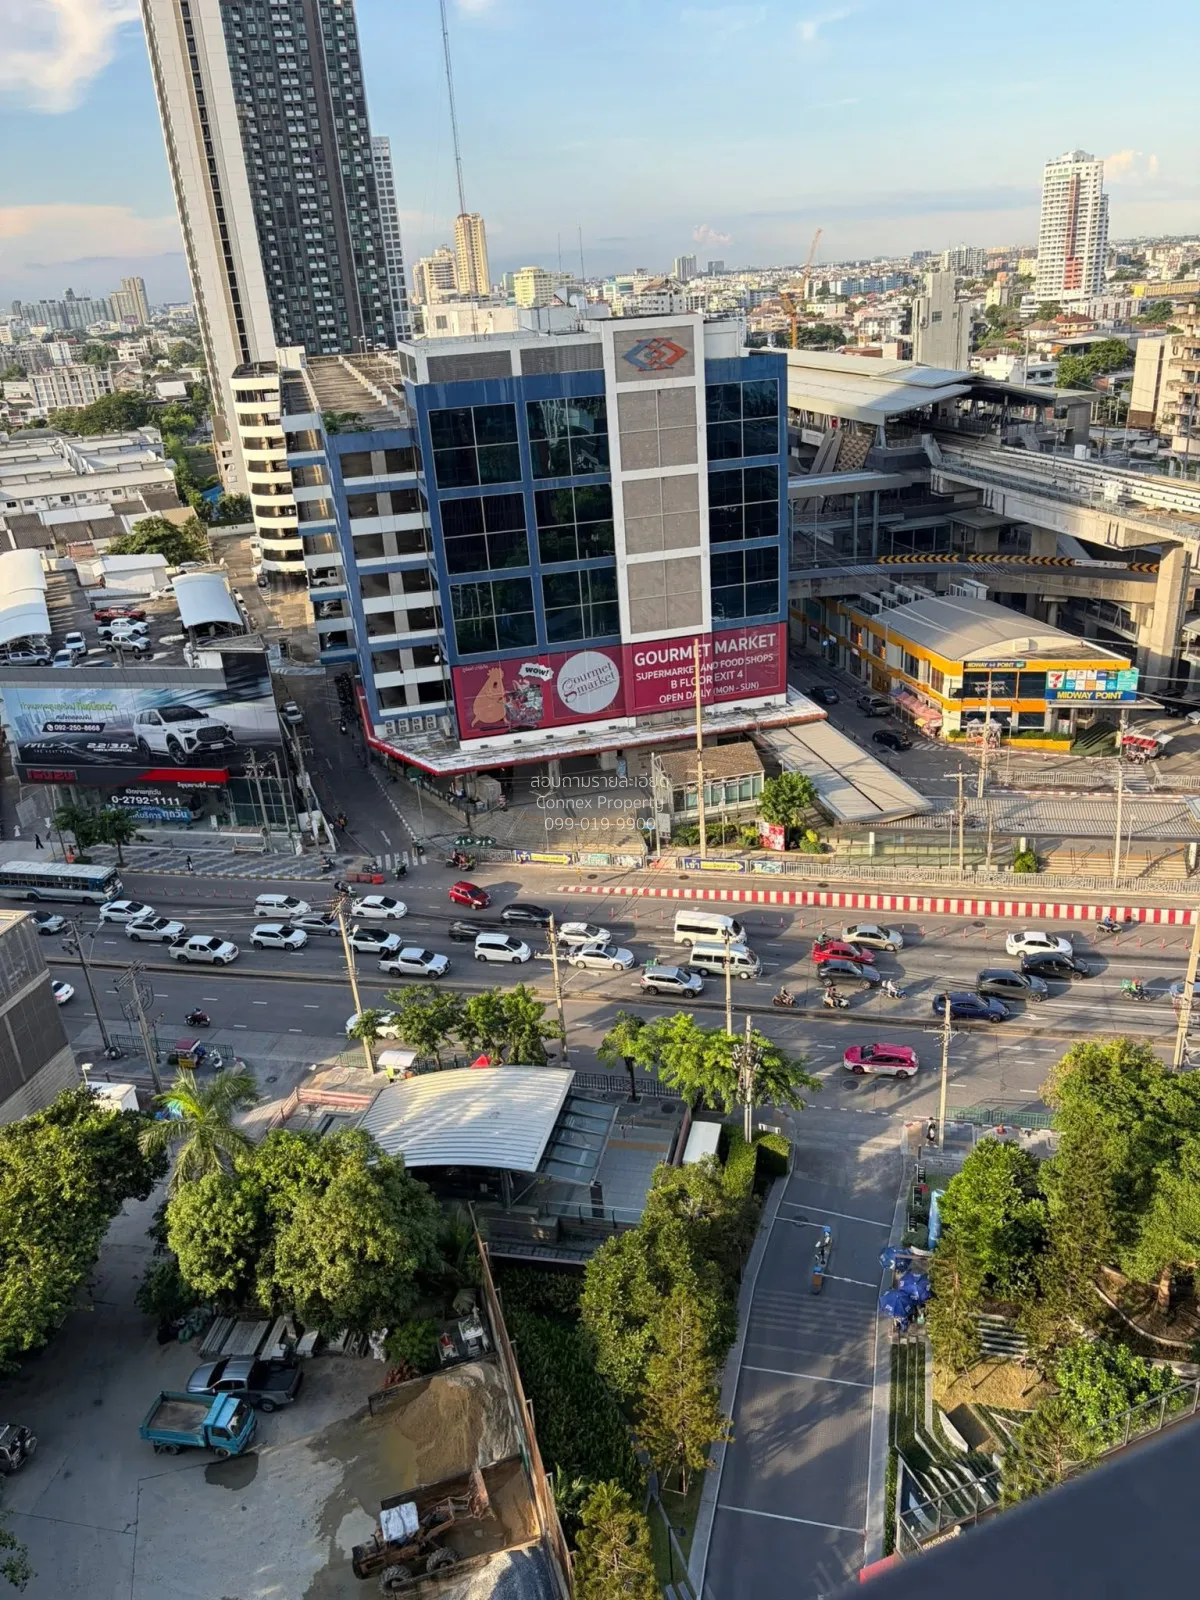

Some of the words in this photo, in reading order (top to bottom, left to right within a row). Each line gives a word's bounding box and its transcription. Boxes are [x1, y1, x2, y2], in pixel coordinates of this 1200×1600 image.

[714, 632, 777, 655] MARKET
[525, 666, 549, 677] WOW!
[636, 666, 699, 681] SUPERMARKE
[700, 661, 719, 672] AND
[720, 658, 744, 670] FOOD
[745, 653, 774, 666] SHOPS
[670, 679, 677, 689] B
[680, 675, 713, 688] FLOOR
[714, 671, 735, 682] EXIT
[737, 669, 743, 678] 4
[659, 692, 684, 703] OPEN
[685, 688, 711, 699] DALY
[713, 685, 734, 695] (MON
[741, 681, 760, 692] SUN)
[1057, 691, 1093, 699] MIDWAY
[111, 795, 180, 806] 0-2792-1111
